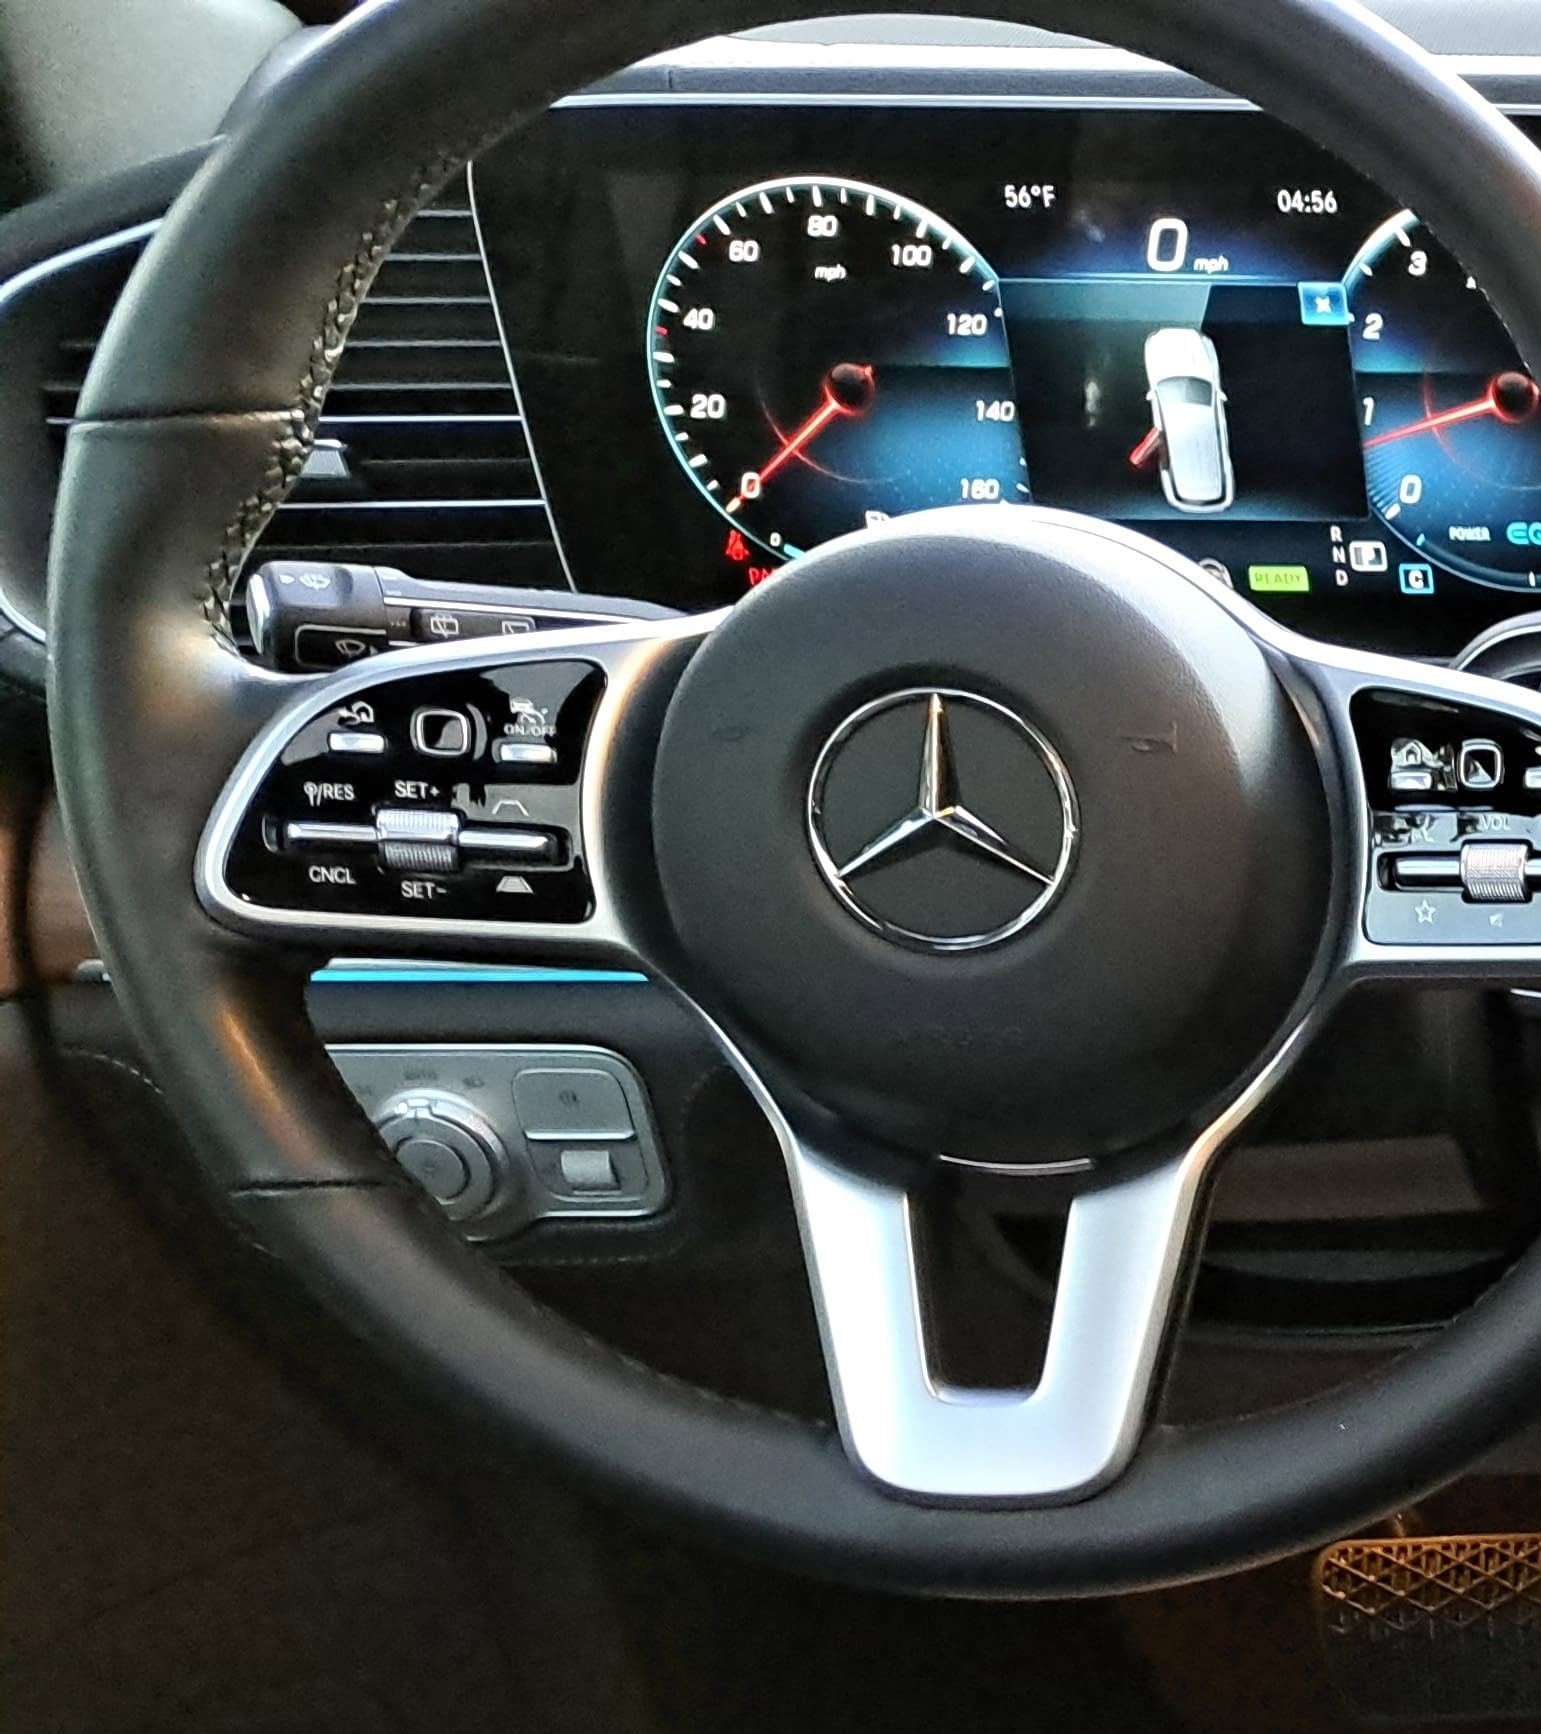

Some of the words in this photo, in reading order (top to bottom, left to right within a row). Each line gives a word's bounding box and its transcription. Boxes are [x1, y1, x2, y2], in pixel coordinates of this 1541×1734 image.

[1277, 188, 1337, 213] 04:56
[807, 215, 837, 237] 80
[728, 240, 759, 262] 60
[891, 244, 932, 267] 100
[1147, 218, 1187, 271] 0
[1194, 254, 1228, 273] mph
[814, 264, 846, 281] mph
[1407, 250, 1427, 276] 3
[683, 308, 714, 330] 40
[946, 314, 987, 335] 120
[1361, 314, 1383, 340] 2
[690, 394, 725, 419] 20
[975, 400, 1014, 422] 140
[1361, 397, 1375, 425] 1
[740, 472, 760, 499] 0
[1400, 474, 1422, 504] 0
[1332, 545, 1346, 564] N
[1335, 568, 1348, 587] D
[308, 865, 356, 884] CNCL
